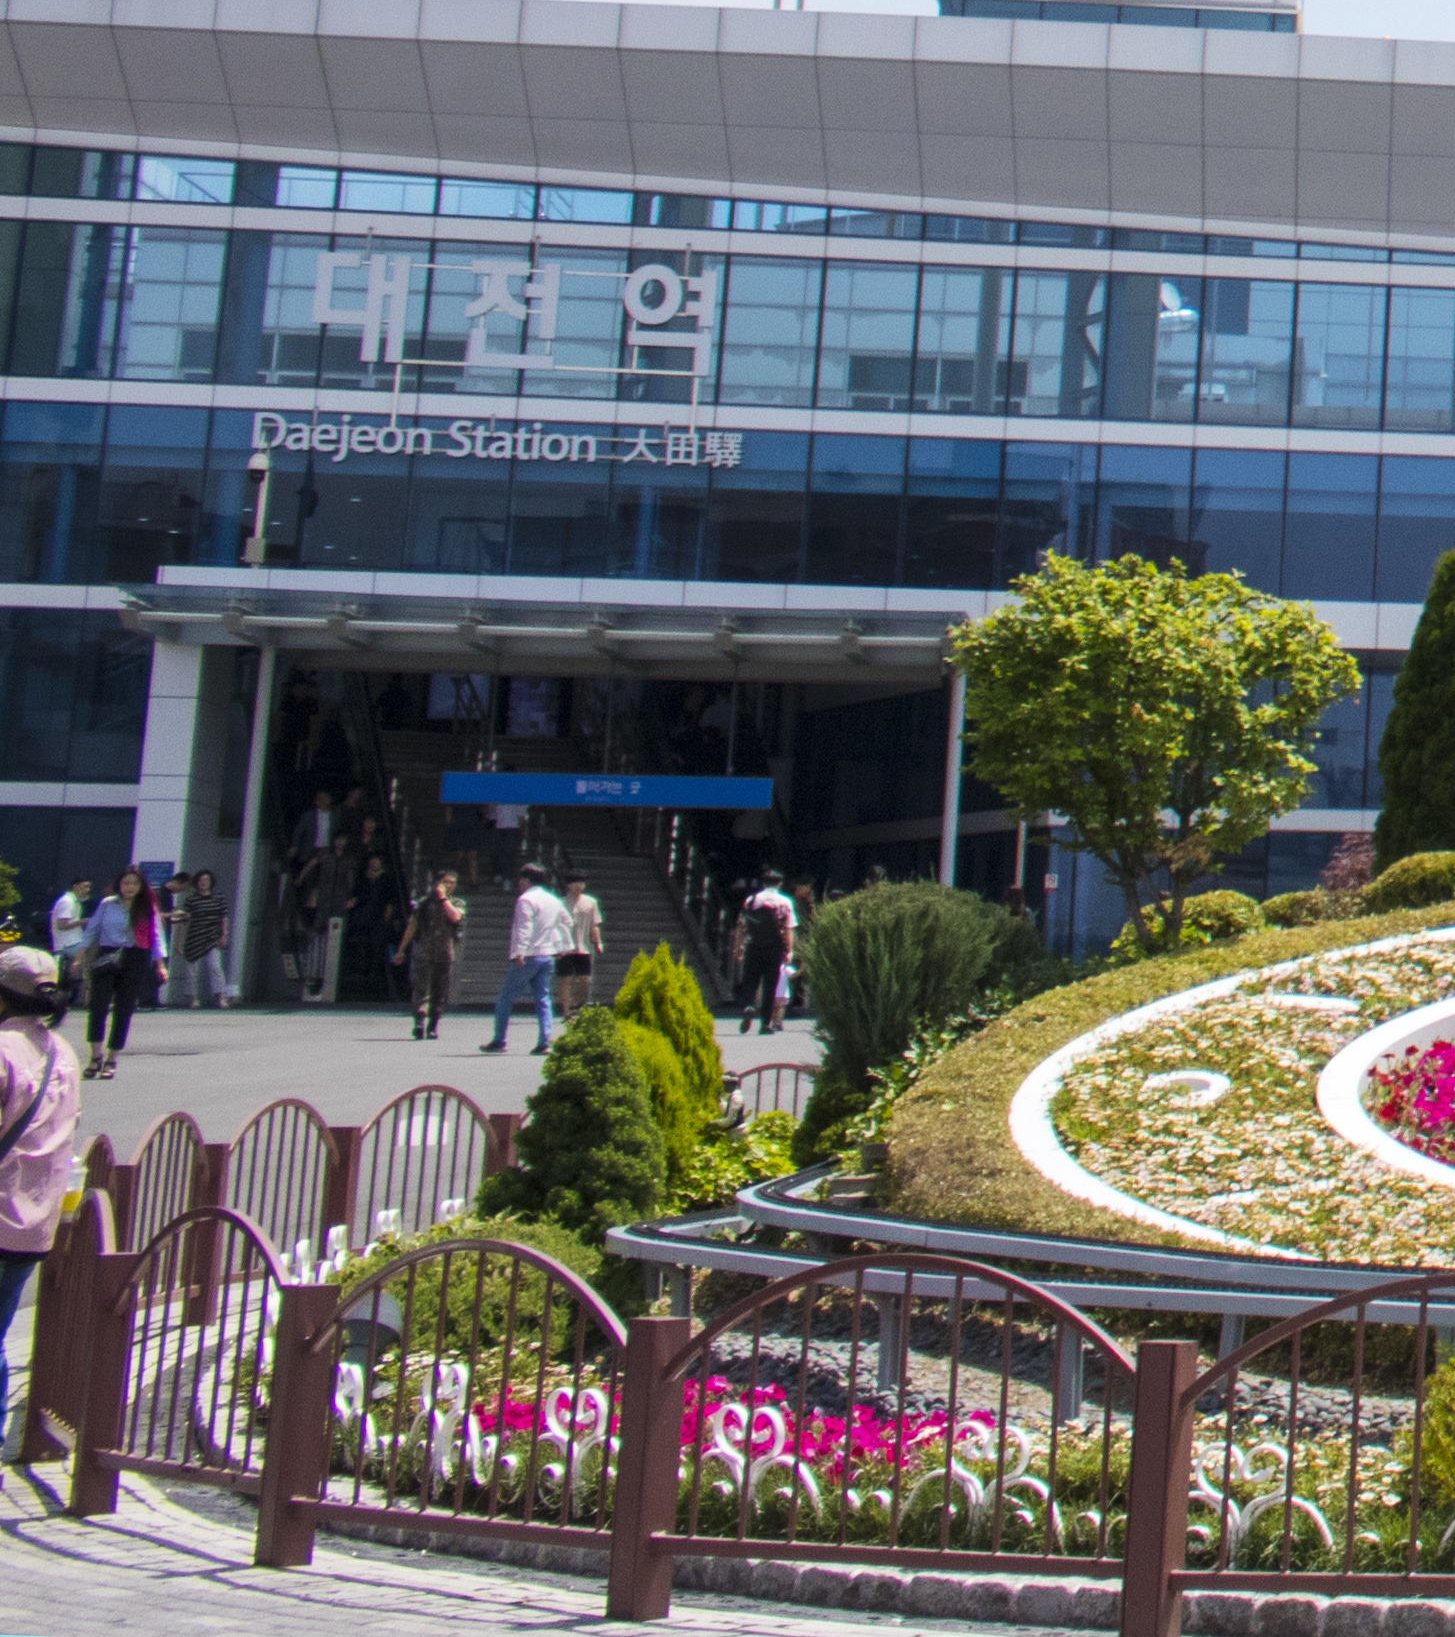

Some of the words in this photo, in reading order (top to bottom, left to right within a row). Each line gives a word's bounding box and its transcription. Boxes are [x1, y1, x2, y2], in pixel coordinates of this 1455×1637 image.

[312, 250, 718, 377] 대전역
[252, 411, 433, 462] Daejeon
[447, 419, 597, 462] Station
